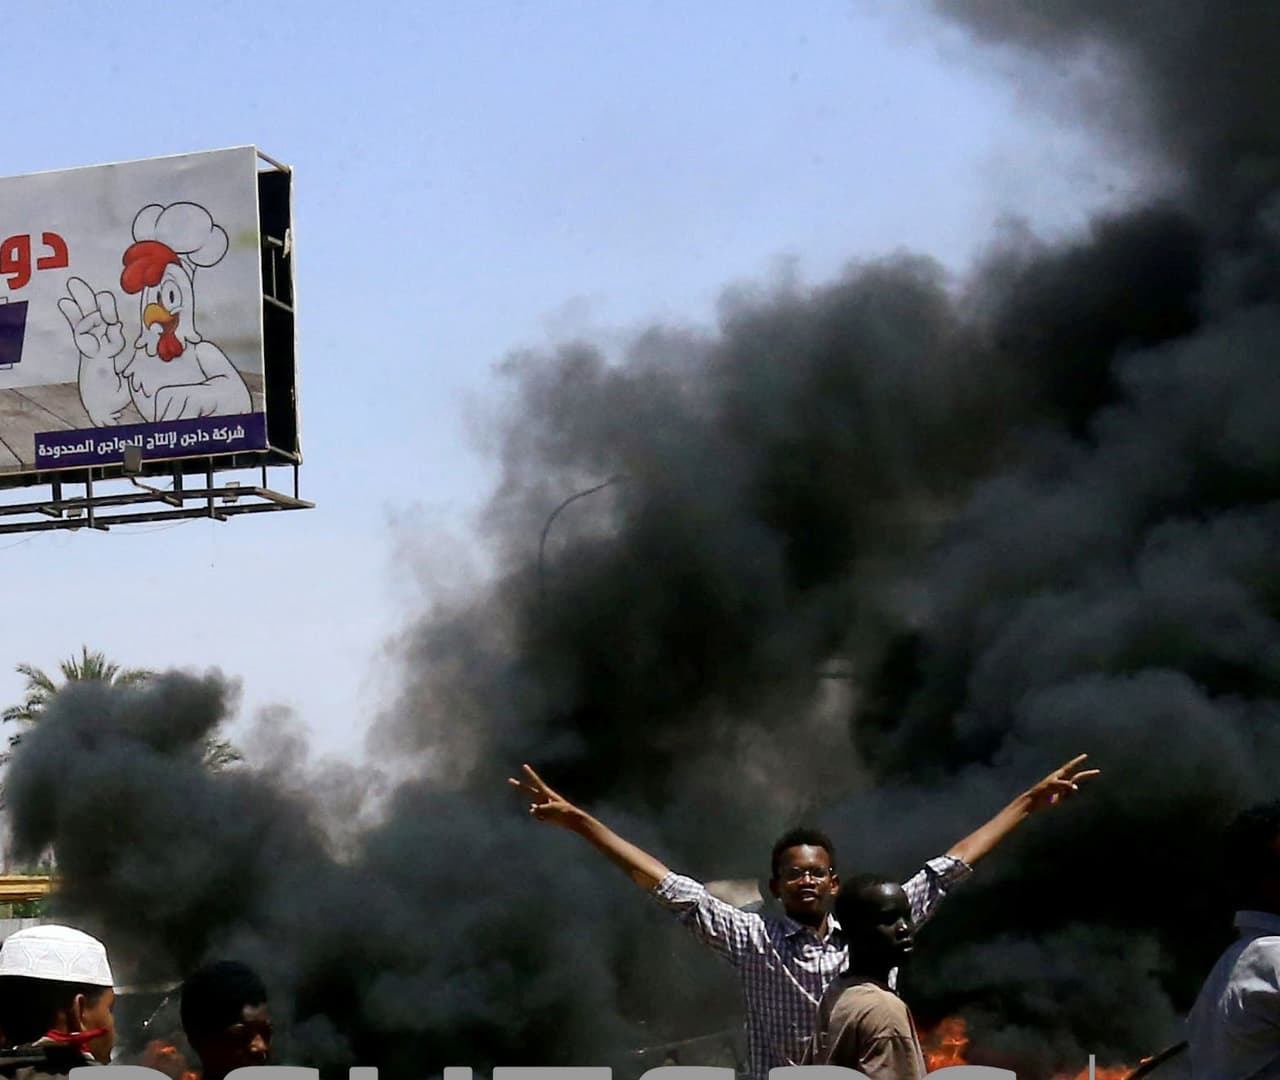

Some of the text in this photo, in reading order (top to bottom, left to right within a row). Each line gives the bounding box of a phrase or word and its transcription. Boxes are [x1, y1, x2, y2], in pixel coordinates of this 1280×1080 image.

[39, 425, 245, 459] شركة داجن لإنتاج الدواجن المحدودة
